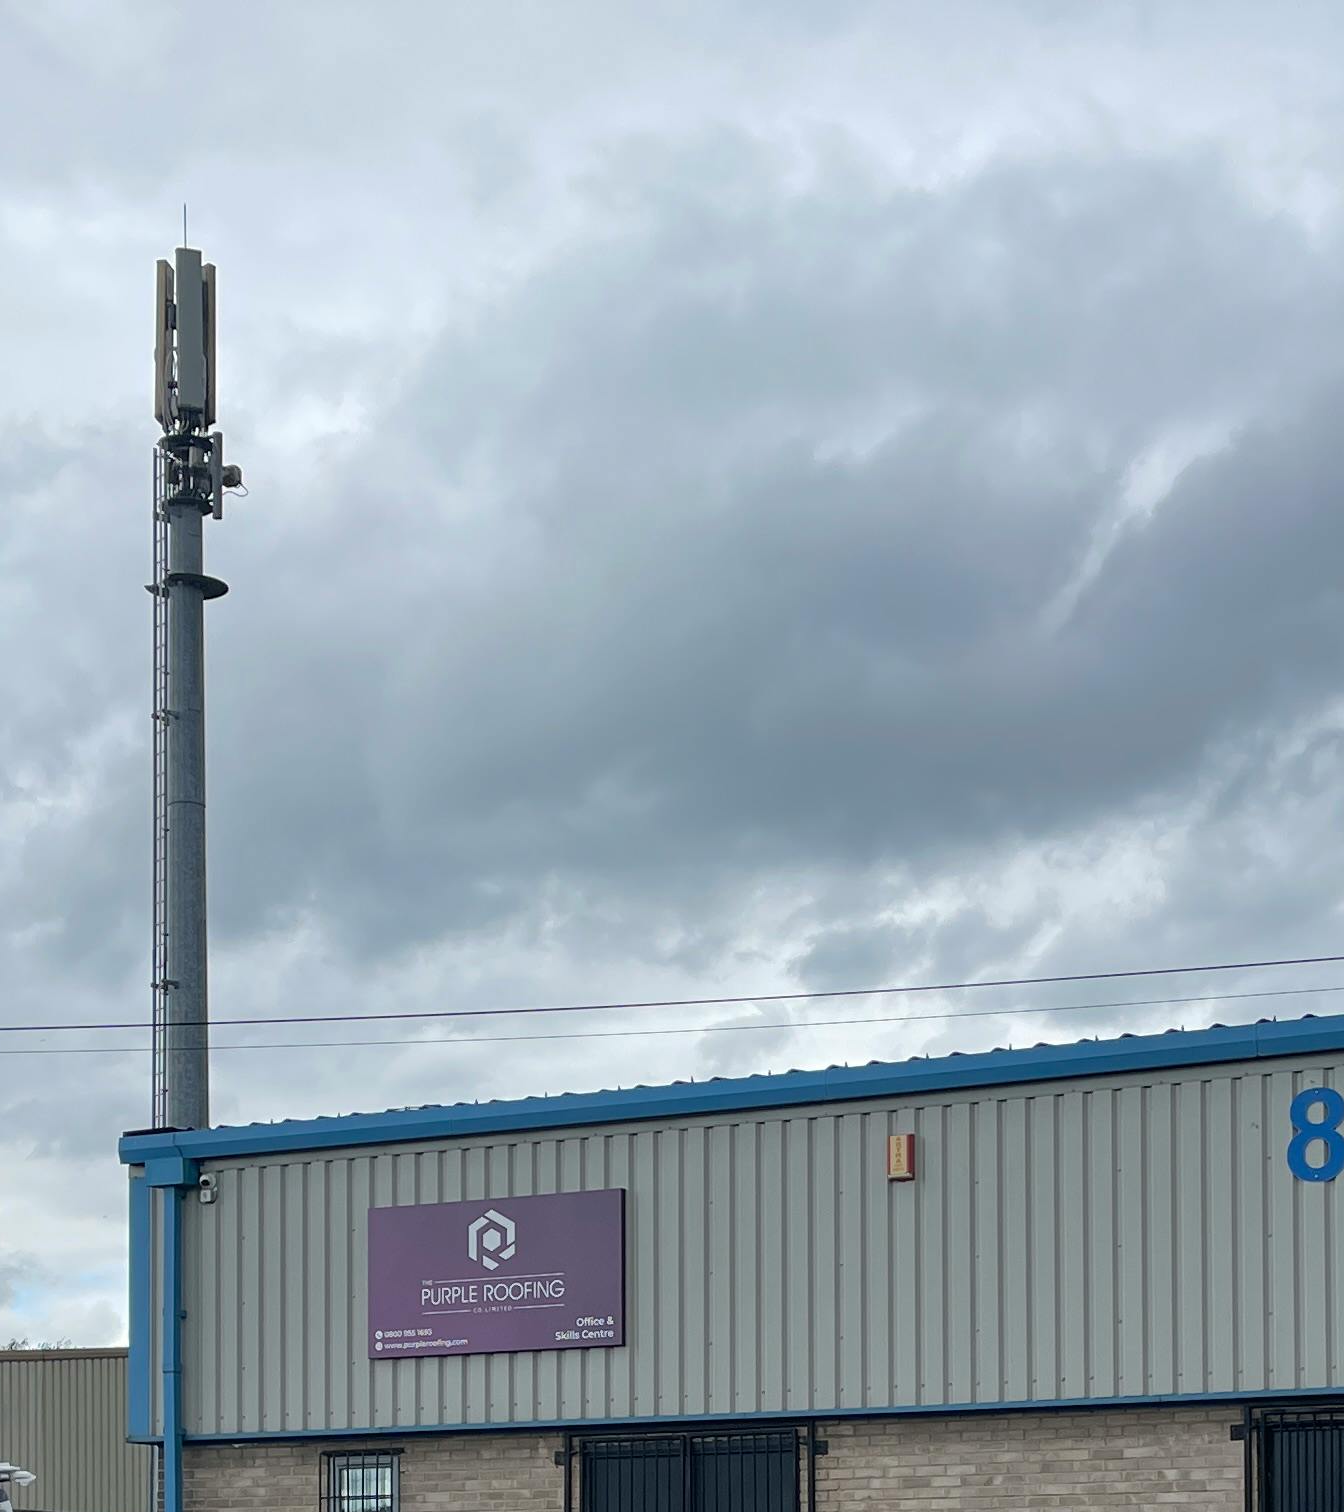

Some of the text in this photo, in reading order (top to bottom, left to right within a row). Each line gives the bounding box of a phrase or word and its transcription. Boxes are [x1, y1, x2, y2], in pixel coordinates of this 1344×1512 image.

[421, 1279, 565, 1306] PURPLE ROOFING
[484, 1305, 513, 1313] LIMITED
[576, 1315, 614, 1327] Office &
[554, 1329, 614, 1341] Skills Centre
